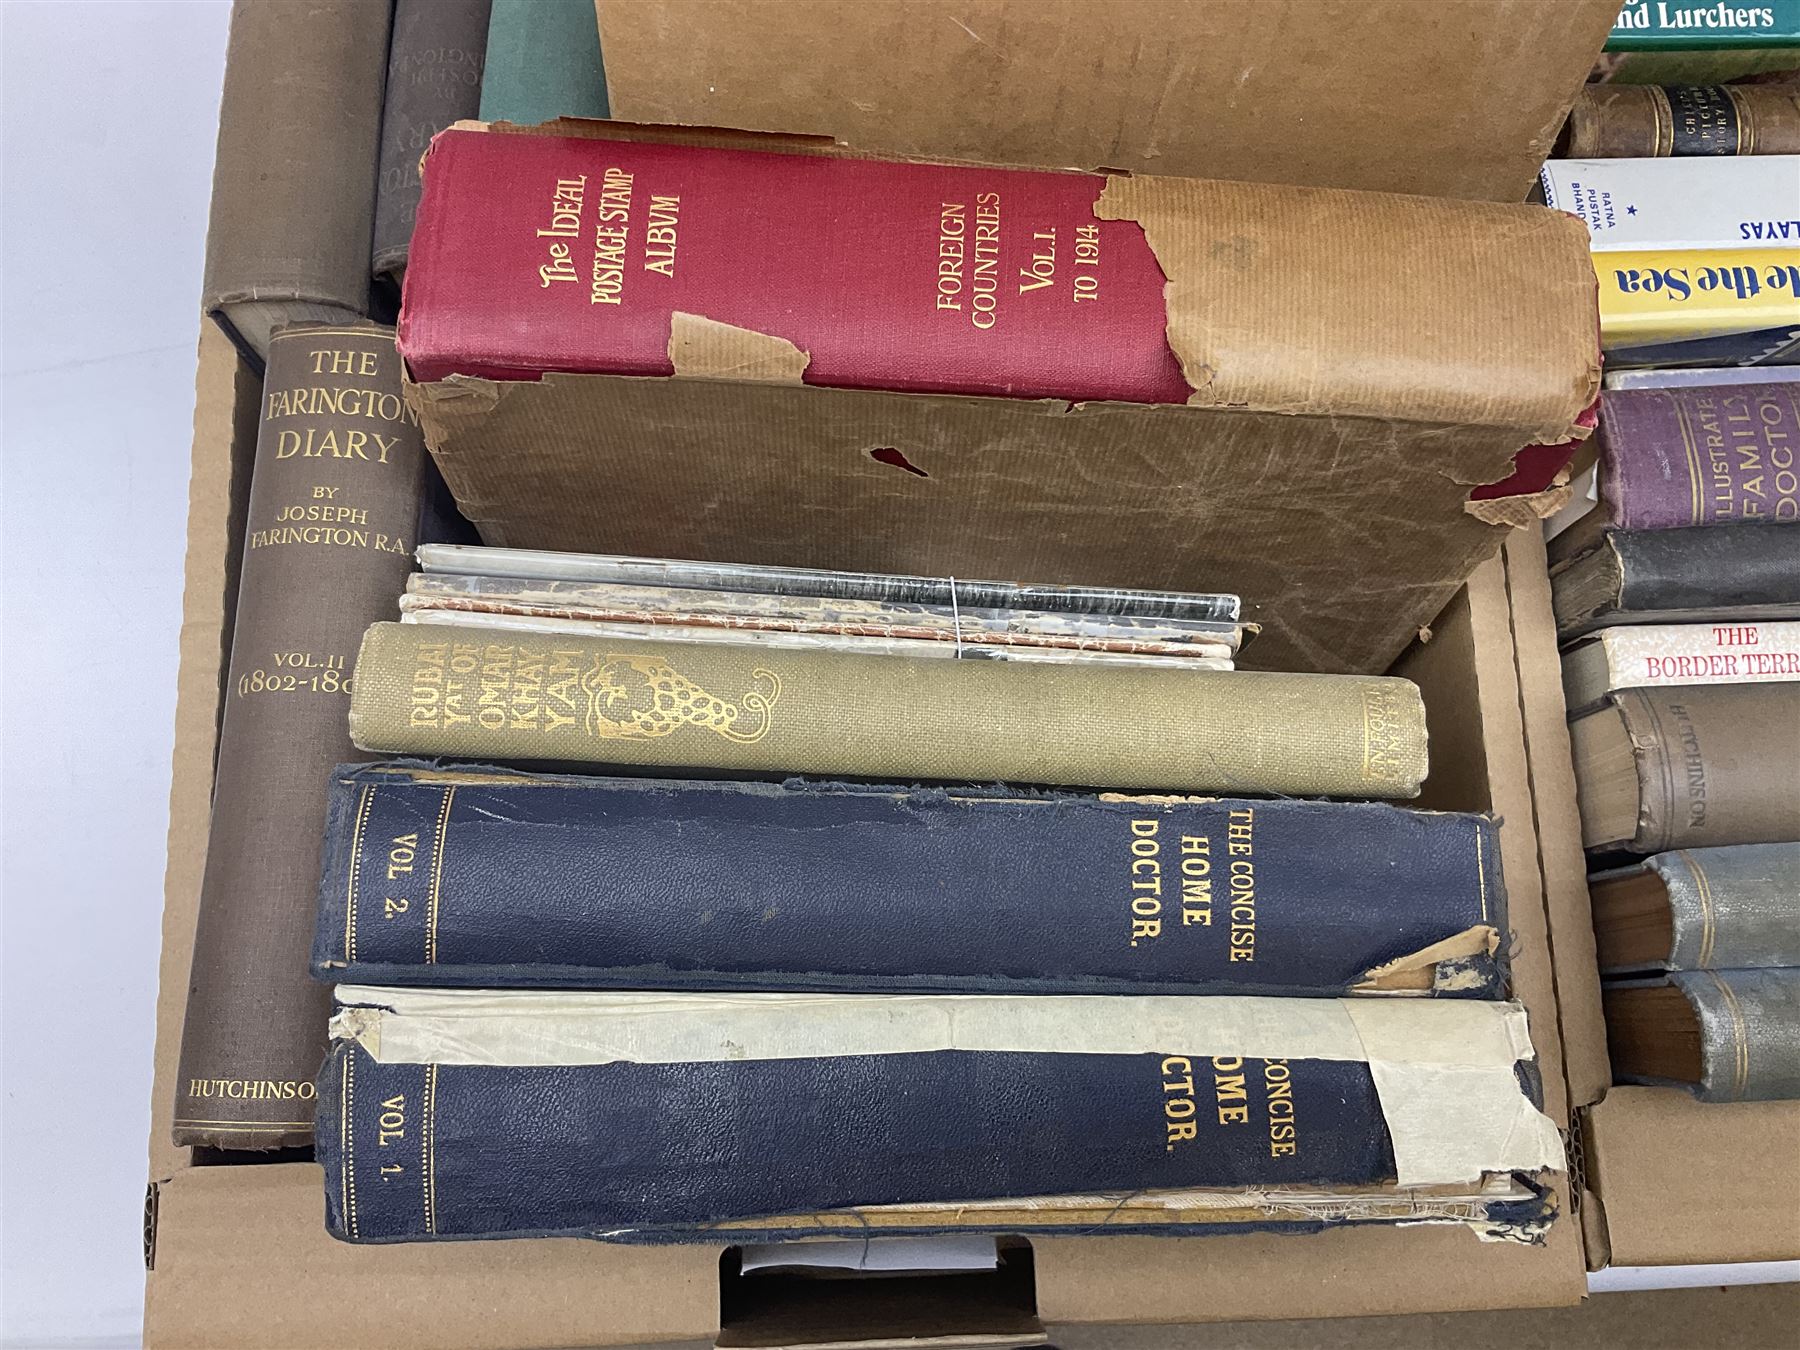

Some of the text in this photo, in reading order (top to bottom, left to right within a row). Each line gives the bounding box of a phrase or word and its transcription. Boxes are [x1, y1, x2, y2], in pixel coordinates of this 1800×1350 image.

[1610, 2, 1775, 29] nd Lurchers
[1586, 188, 1602, 231] PUSTAK
[1601, 192, 1617, 229] RATNA
[591, 167, 635, 306] POSTAGE STAMP
[644, 194, 681, 279] ALBVM
[936, 202, 966, 311] FOREIGN
[971, 192, 1001, 330] COUNTRIES
[539, 243, 579, 289] The
[1073, 224, 1100, 303] TO 1914
[1614, 267, 1692, 302] Sea
[1697, 265, 1763, 300] the
[309, 350, 379, 377] THE
[266, 387, 420, 428] FARINGTON
[275, 429, 402, 465] DIARY
[1723, 395, 1768, 519] FAMILY
[276, 506, 369, 526] JOSEPH
[312, 486, 340, 499] BY
[251, 527, 370, 550] FARINGTON
[1712, 627, 1759, 646] THE
[410, 642, 449, 729] RUBAI
[478, 645, 515, 730] OMAR
[1645, 652, 1800, 679] BORDER TERR
[544, 650, 585, 733] YAM
[1669, 703, 1707, 829] HUTCHINSON
[1130, 819, 1162, 948] DOCTOR.
[1181, 834, 1213, 927] HOME
[1228, 807, 1256, 963] THE CONCISE
[384, 896, 409, 920] 2.
[188, 1079, 319, 1100] HUTCHINSO
[1160, 1056, 1198, 1152] CTOR.
[1211, 1055, 1249, 1126] OME
[378, 1093, 405, 1147] VOL
